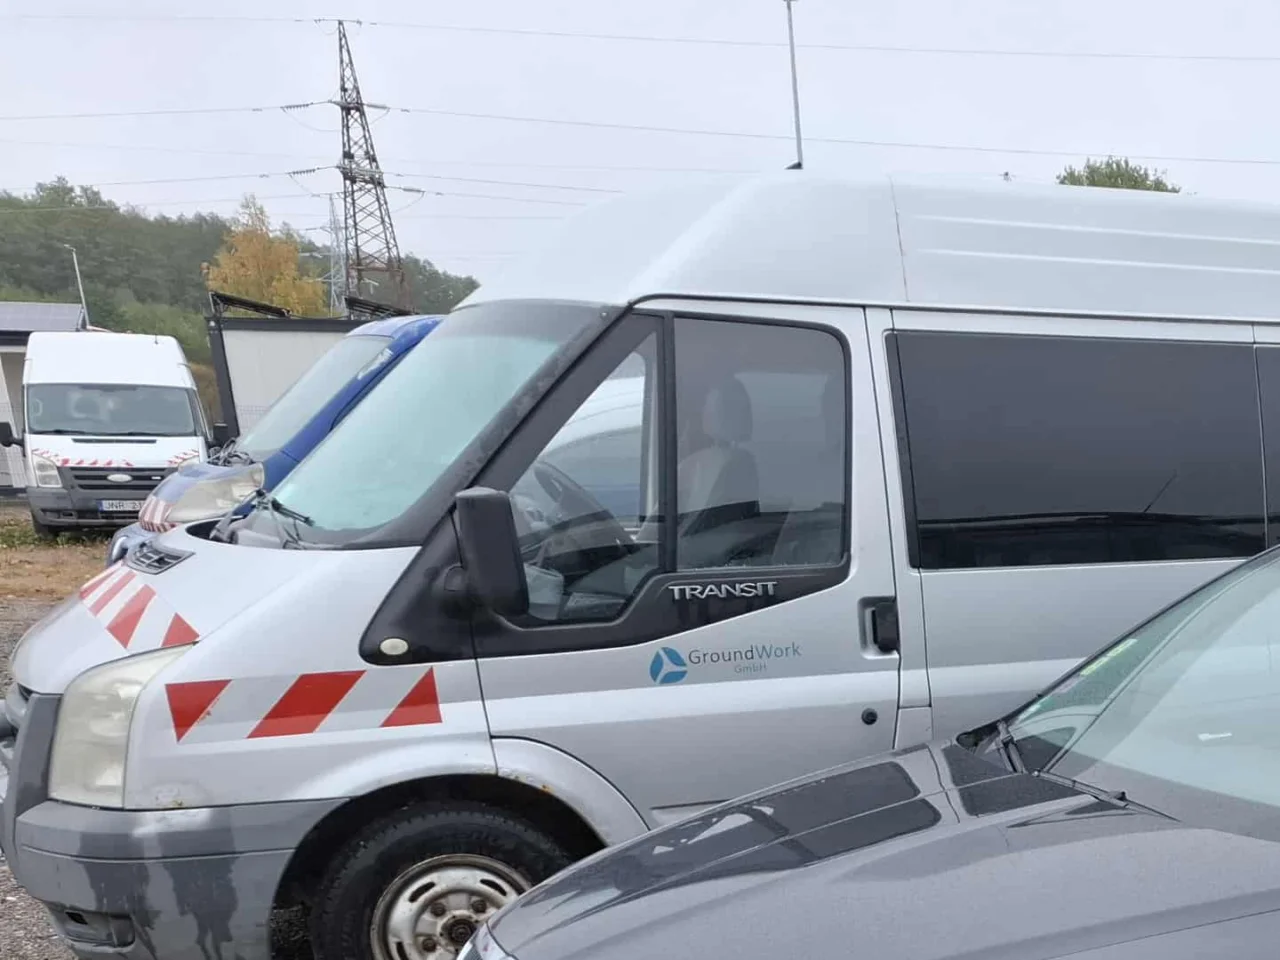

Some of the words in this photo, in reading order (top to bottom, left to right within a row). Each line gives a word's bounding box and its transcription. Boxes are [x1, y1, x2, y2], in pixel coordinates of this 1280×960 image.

[668, 581, 778, 601] TRANSIT
[688, 642, 803, 665] GroundWork
[734, 664, 768, 674] GmbH
